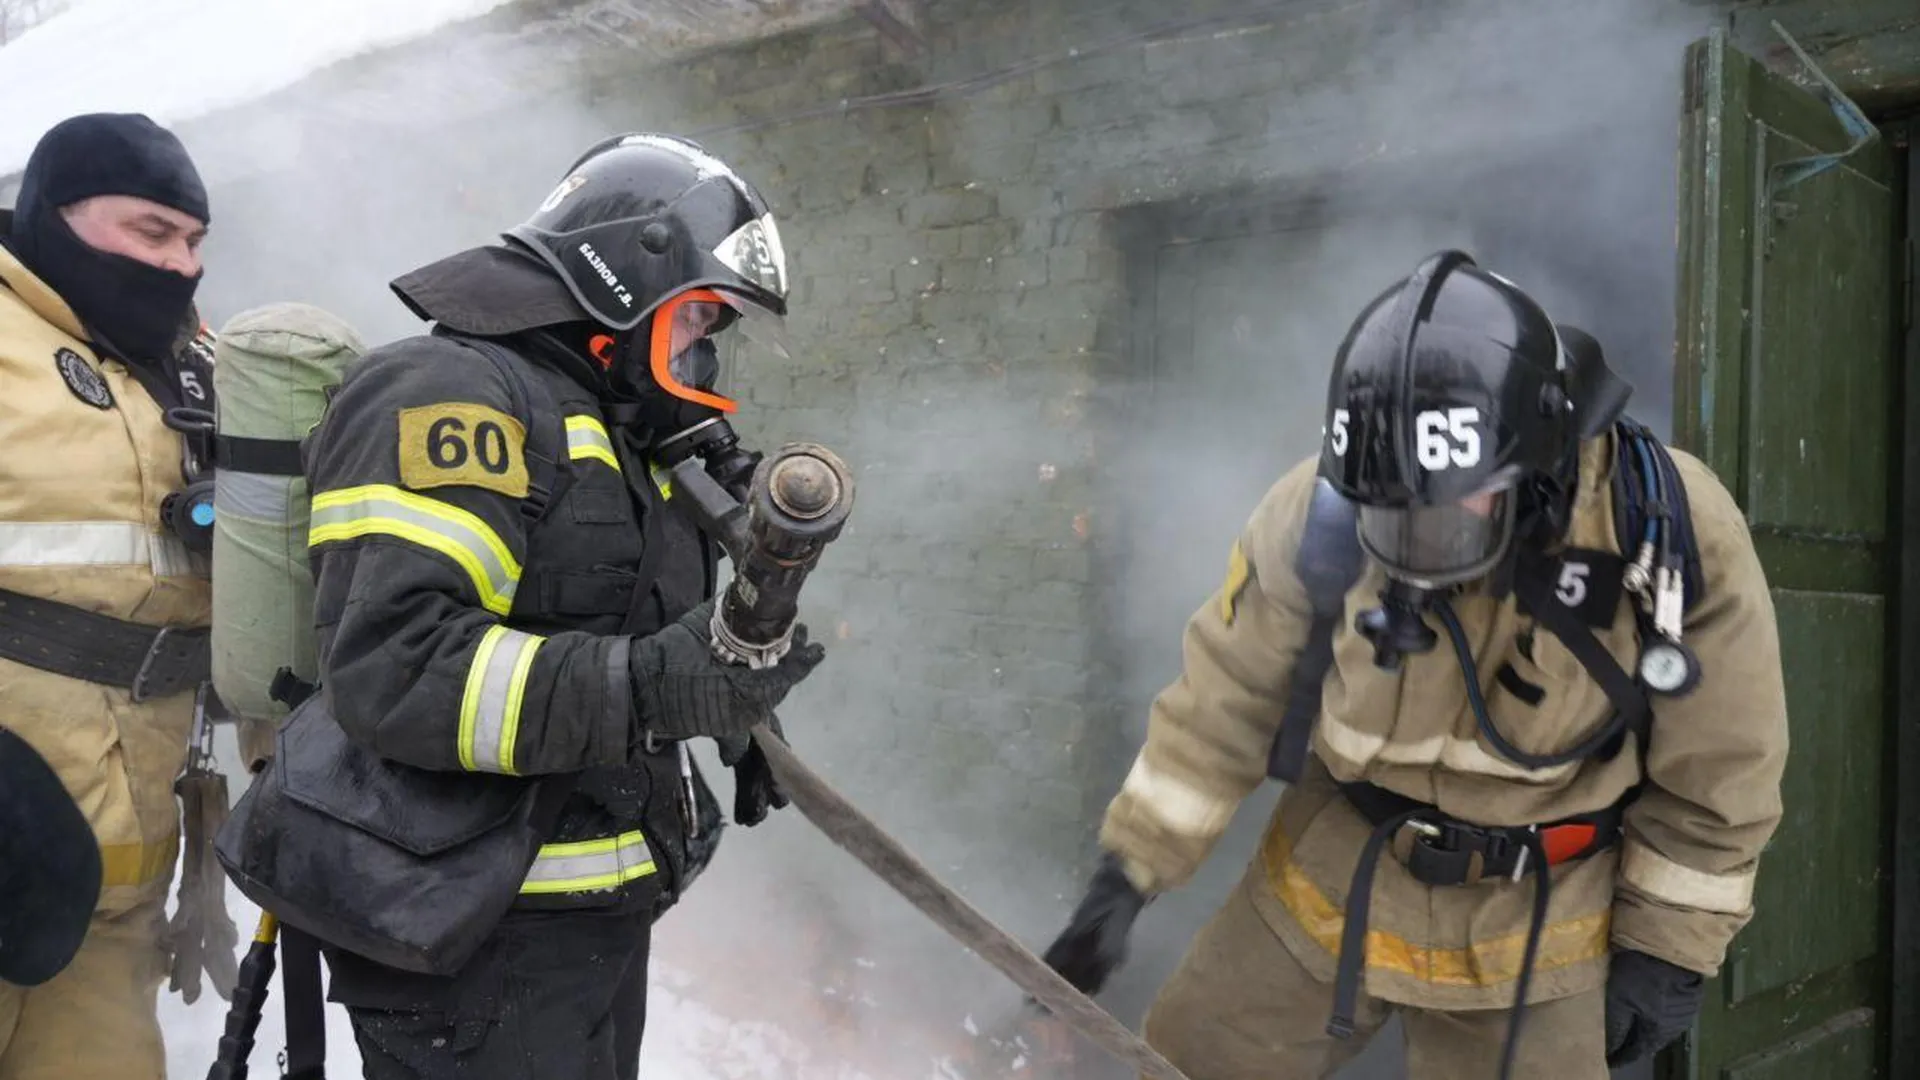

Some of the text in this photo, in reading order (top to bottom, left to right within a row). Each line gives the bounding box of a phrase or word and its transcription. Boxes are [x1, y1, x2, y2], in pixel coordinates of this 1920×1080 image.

[579, 243, 633, 308] БАЗЛОВ Г.В.
[179, 371, 205, 400] 5
[427, 417, 509, 475] 60
[1416, 407, 1481, 471] 65
[1555, 562, 1590, 607] 5
